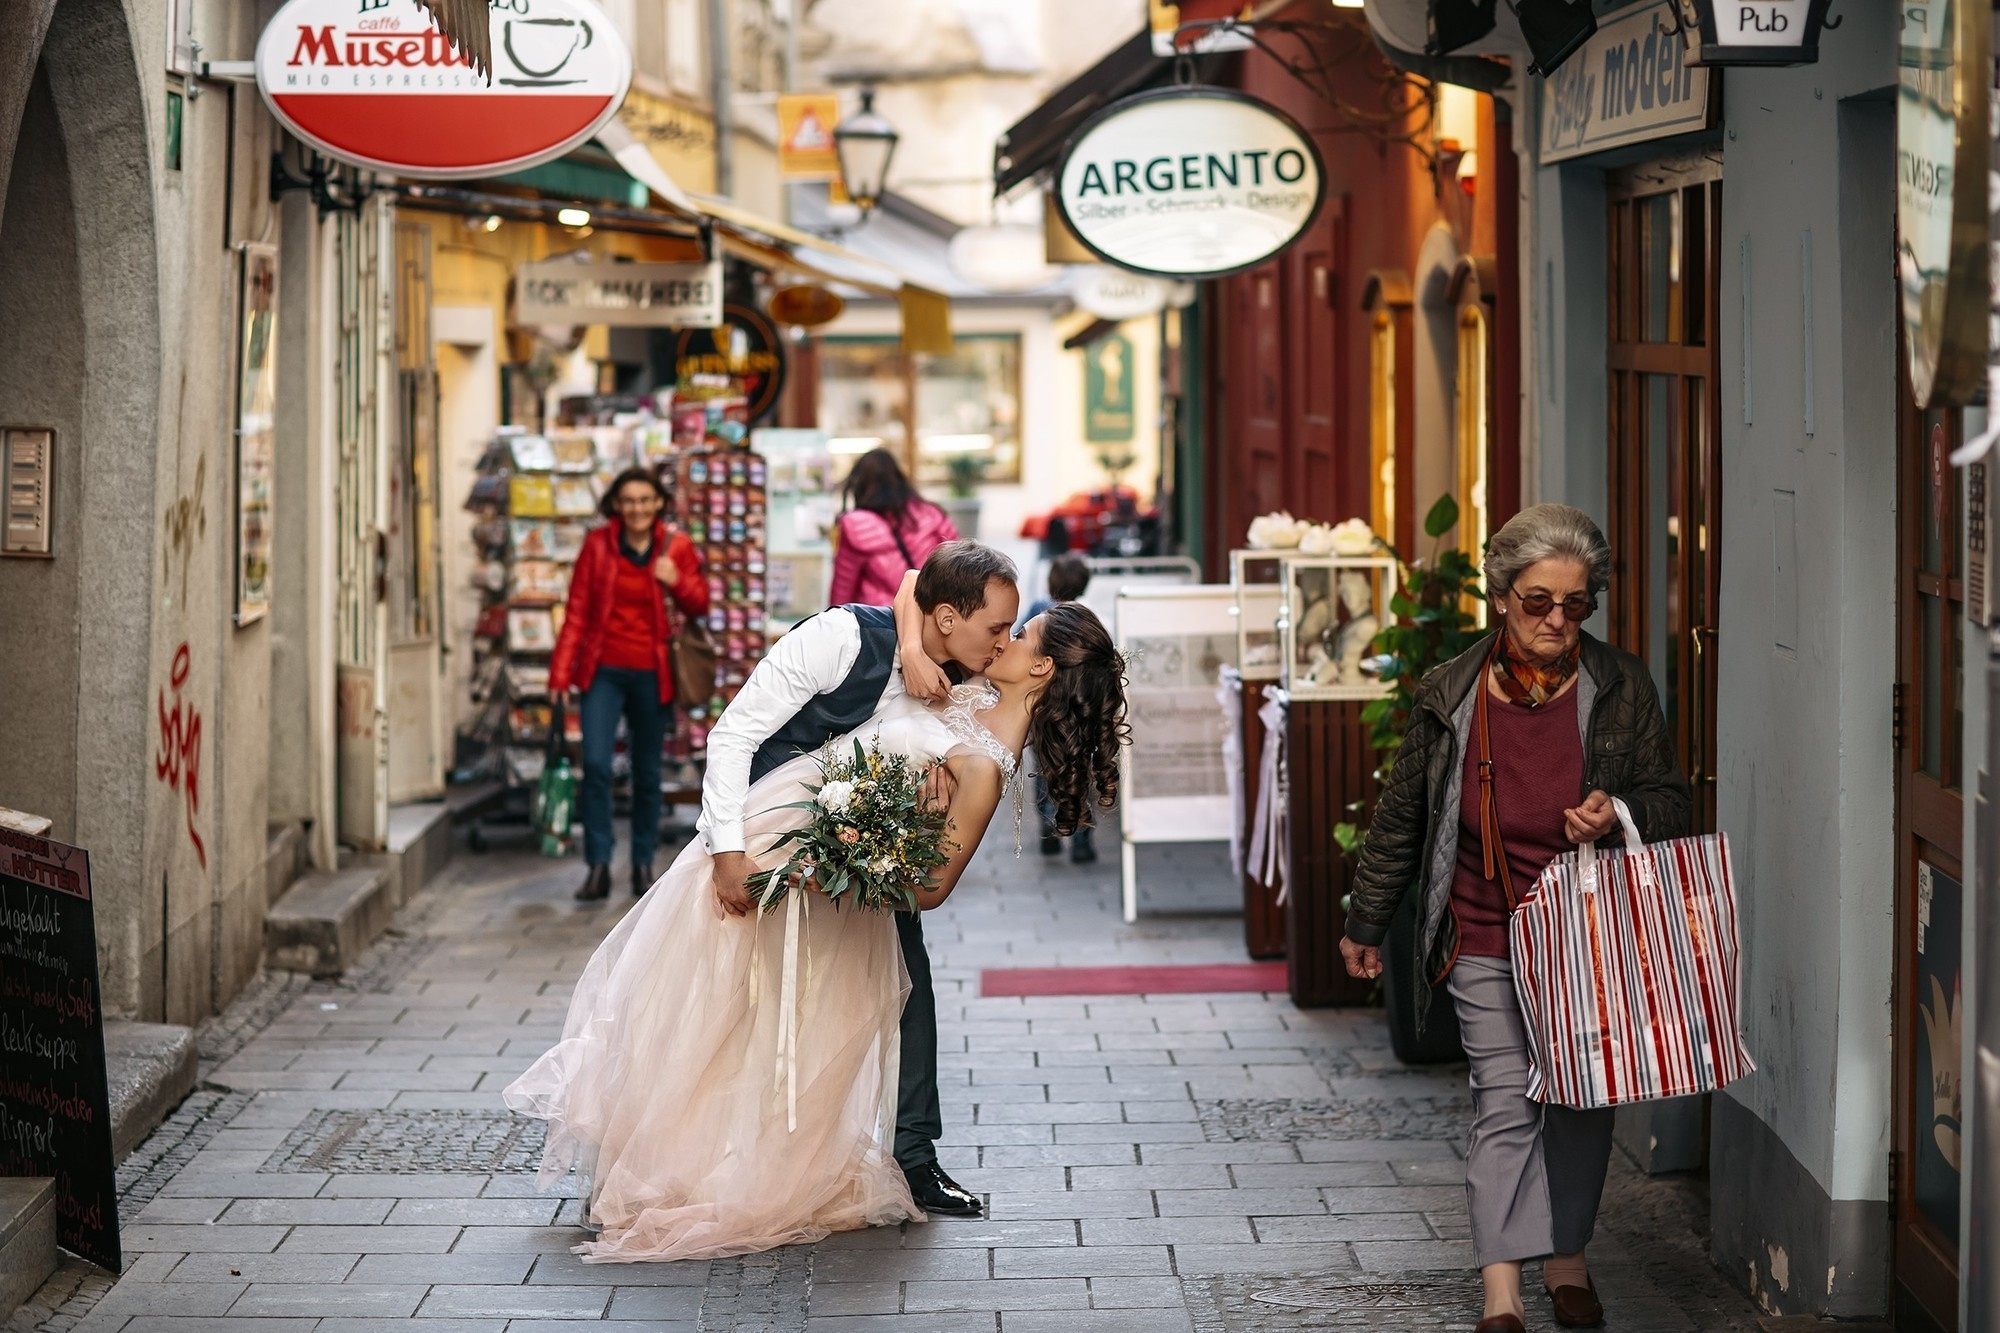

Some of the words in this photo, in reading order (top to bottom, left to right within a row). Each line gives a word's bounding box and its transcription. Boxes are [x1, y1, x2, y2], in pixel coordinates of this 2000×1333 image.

[358, 17, 401, 31] caffé
[1739, 7, 1788, 32] Pub
[286, 25, 478, 67] Musett
[287, 74, 330, 87] MIO
[353, 74, 479, 87] ESPRESSO
[1077, 149, 1306, 197] ARGENTO
[1076, 202, 1127, 221] Silber
[1146, 195, 1228, 216] Schmuck
[1246, 189, 1310, 210] Design
[12, 853, 82, 894] HÜTTER
